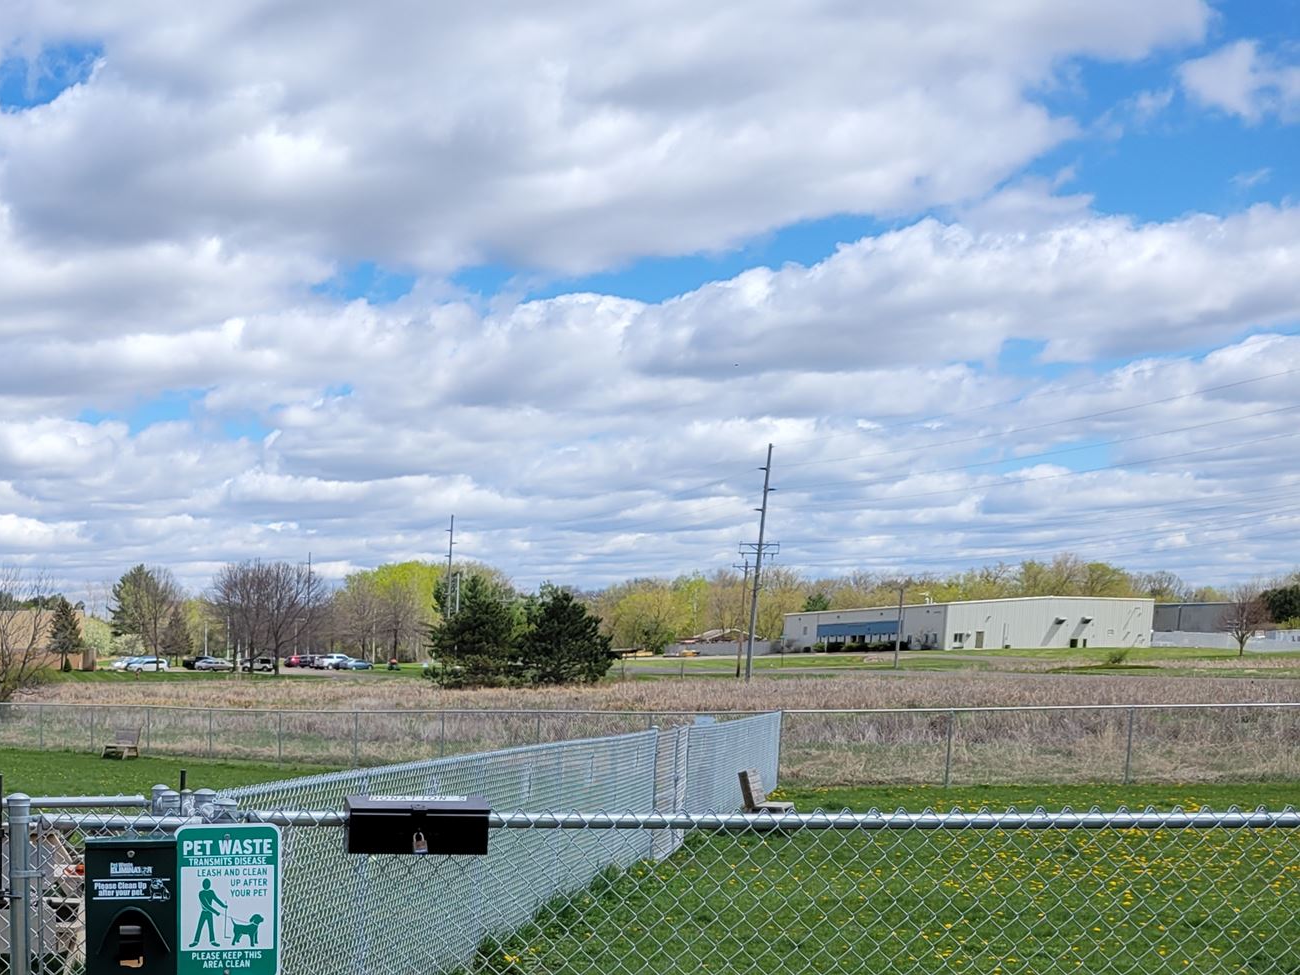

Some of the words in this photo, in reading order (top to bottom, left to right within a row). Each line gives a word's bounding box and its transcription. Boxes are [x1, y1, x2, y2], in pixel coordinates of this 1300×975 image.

[183, 840, 213, 856] PET
[218, 839, 273, 855] WASTE
[188, 858, 232, 866] TRANSMITS
[234, 857, 267, 865] DISEASE
[197, 869, 222, 877] LEASH
[224, 868, 240, 876] AND
[242, 868, 268, 876] CLEAN
[138, 882, 147, 890] Up
[191, 952, 221, 960] PLEASE
[222, 951, 243, 959] KEEP
[244, 951, 262, 959] THIS
[203, 960, 223, 969] AREA
[225, 960, 251, 968] CLEAN
